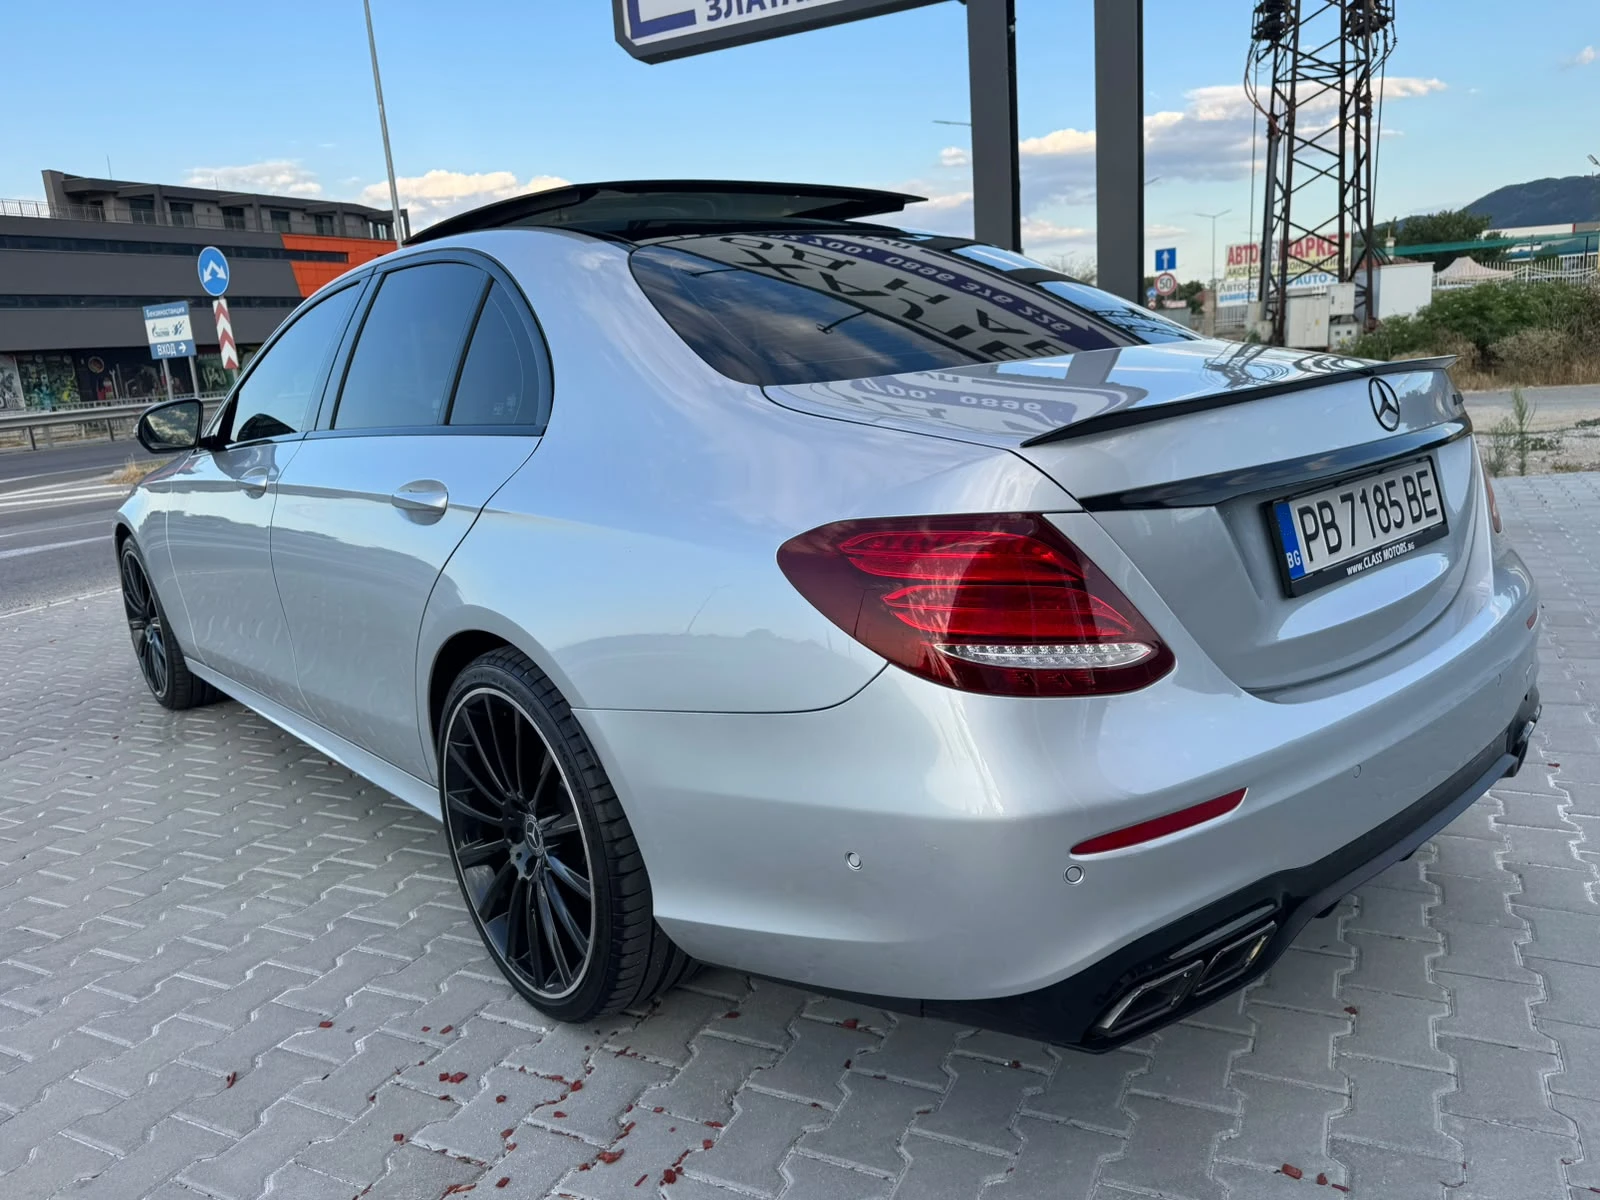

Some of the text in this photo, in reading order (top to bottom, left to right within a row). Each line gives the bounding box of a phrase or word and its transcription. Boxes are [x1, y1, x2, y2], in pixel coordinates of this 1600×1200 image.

[1227, 243, 1259, 266] АВТО
[1280, 233, 1350, 260] АРКЕ
[1159, 277, 1172, 290] 50
[156, 342, 177, 356] ВХОД
[1297, 469, 1438, 563] PB 7185 BE
[1286, 550, 1302, 569] BG
